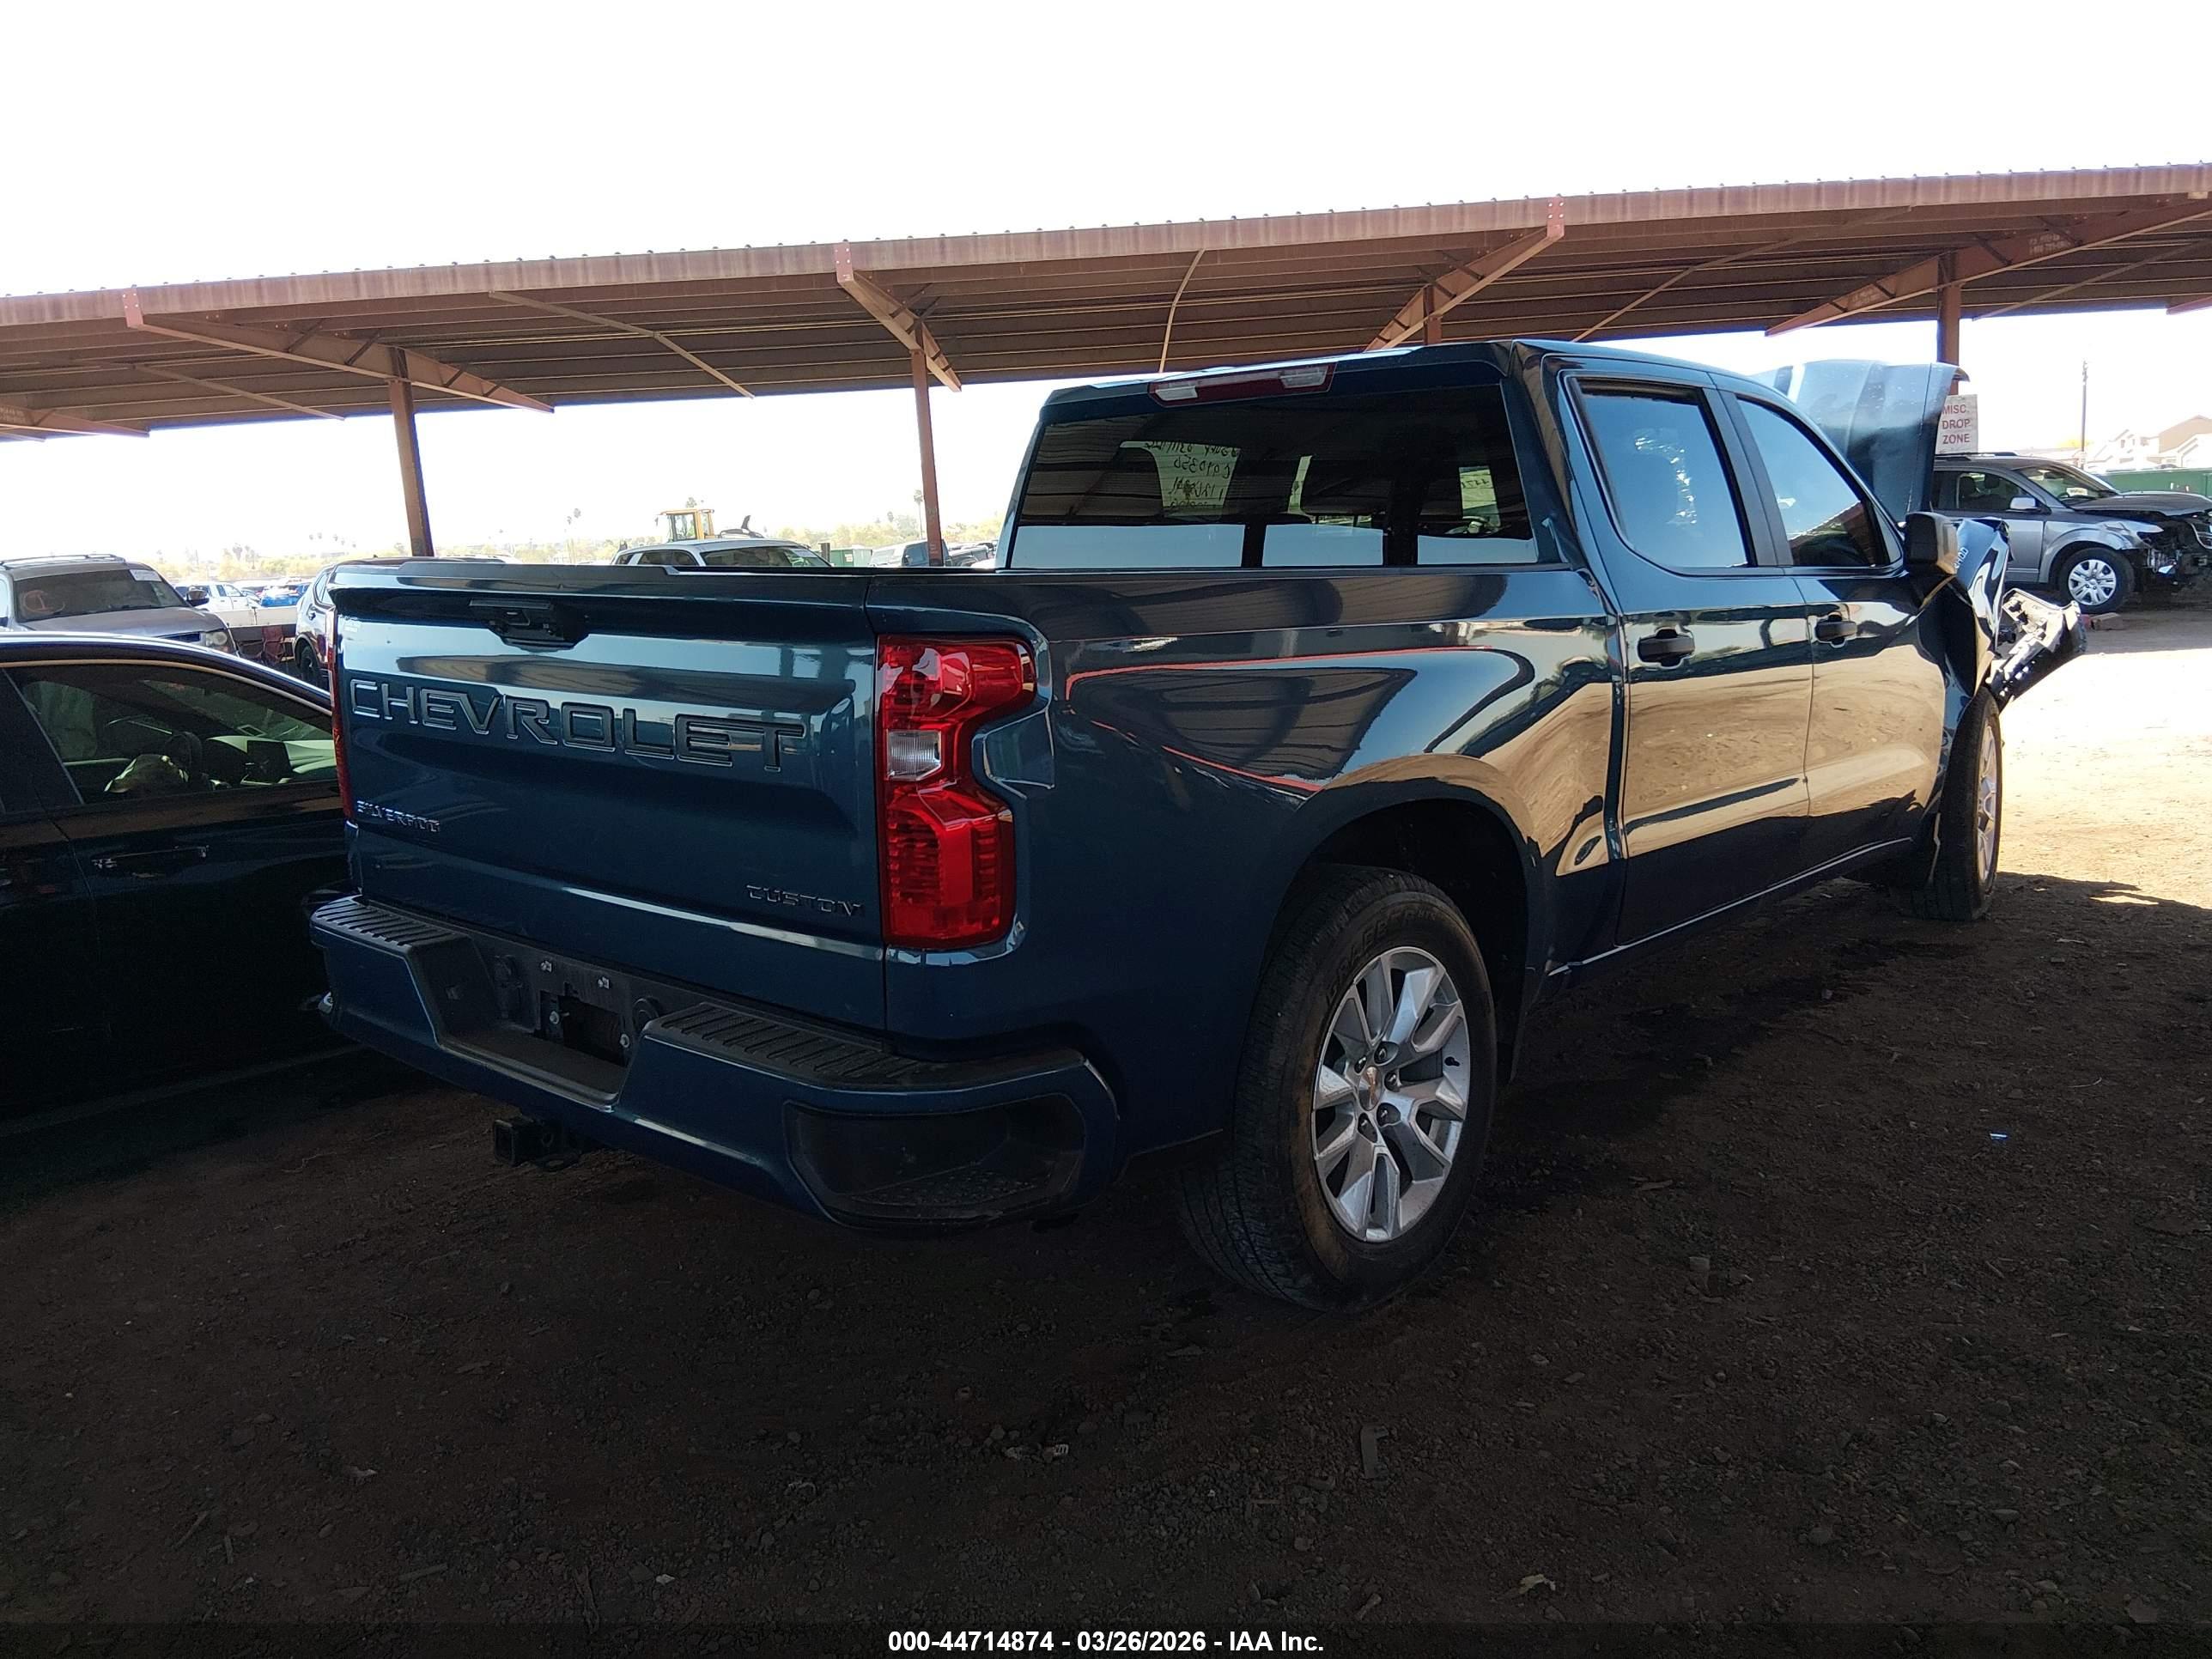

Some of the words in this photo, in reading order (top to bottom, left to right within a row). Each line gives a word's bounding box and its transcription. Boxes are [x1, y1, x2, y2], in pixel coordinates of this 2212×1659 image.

[1942, 404, 1970, 415] MISC.
[1942, 418, 1971, 430] DROP
[1942, 433, 1971, 445] ZONE
[349, 678, 807, 774] CHEVROLET
[356, 799, 441, 833] SILVERADO
[745, 884, 864, 917] CUSTOM
